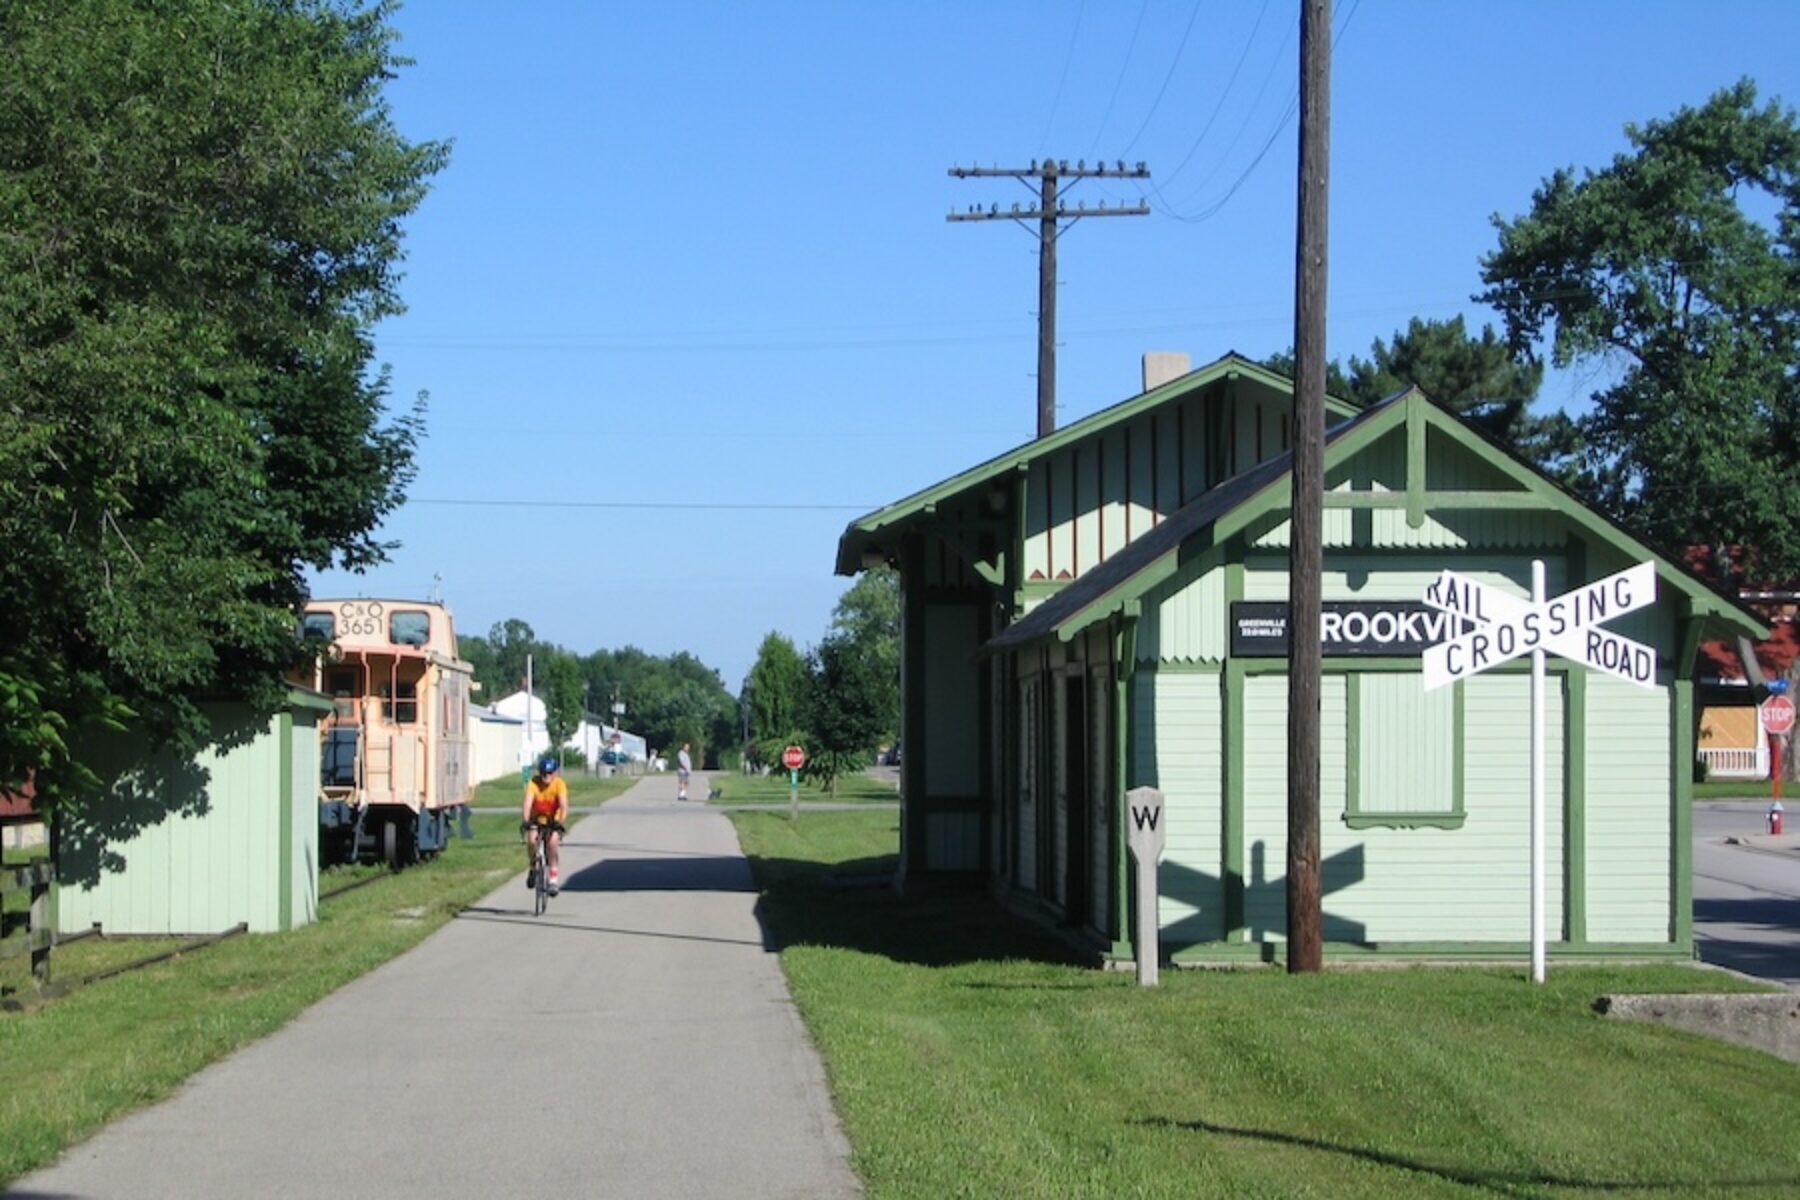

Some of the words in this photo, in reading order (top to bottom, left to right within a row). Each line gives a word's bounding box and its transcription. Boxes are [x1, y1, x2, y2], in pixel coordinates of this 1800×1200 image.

[340, 602, 384, 619] C&O
[340, 618, 384, 635] 3651
[1427, 575, 1491, 623] RAIL
[1587, 630, 1651, 681] ROAD
[1446, 576, 1632, 675] CROSSING
[1763, 707, 1793, 721] STOP
[1132, 805, 1161, 831] W
